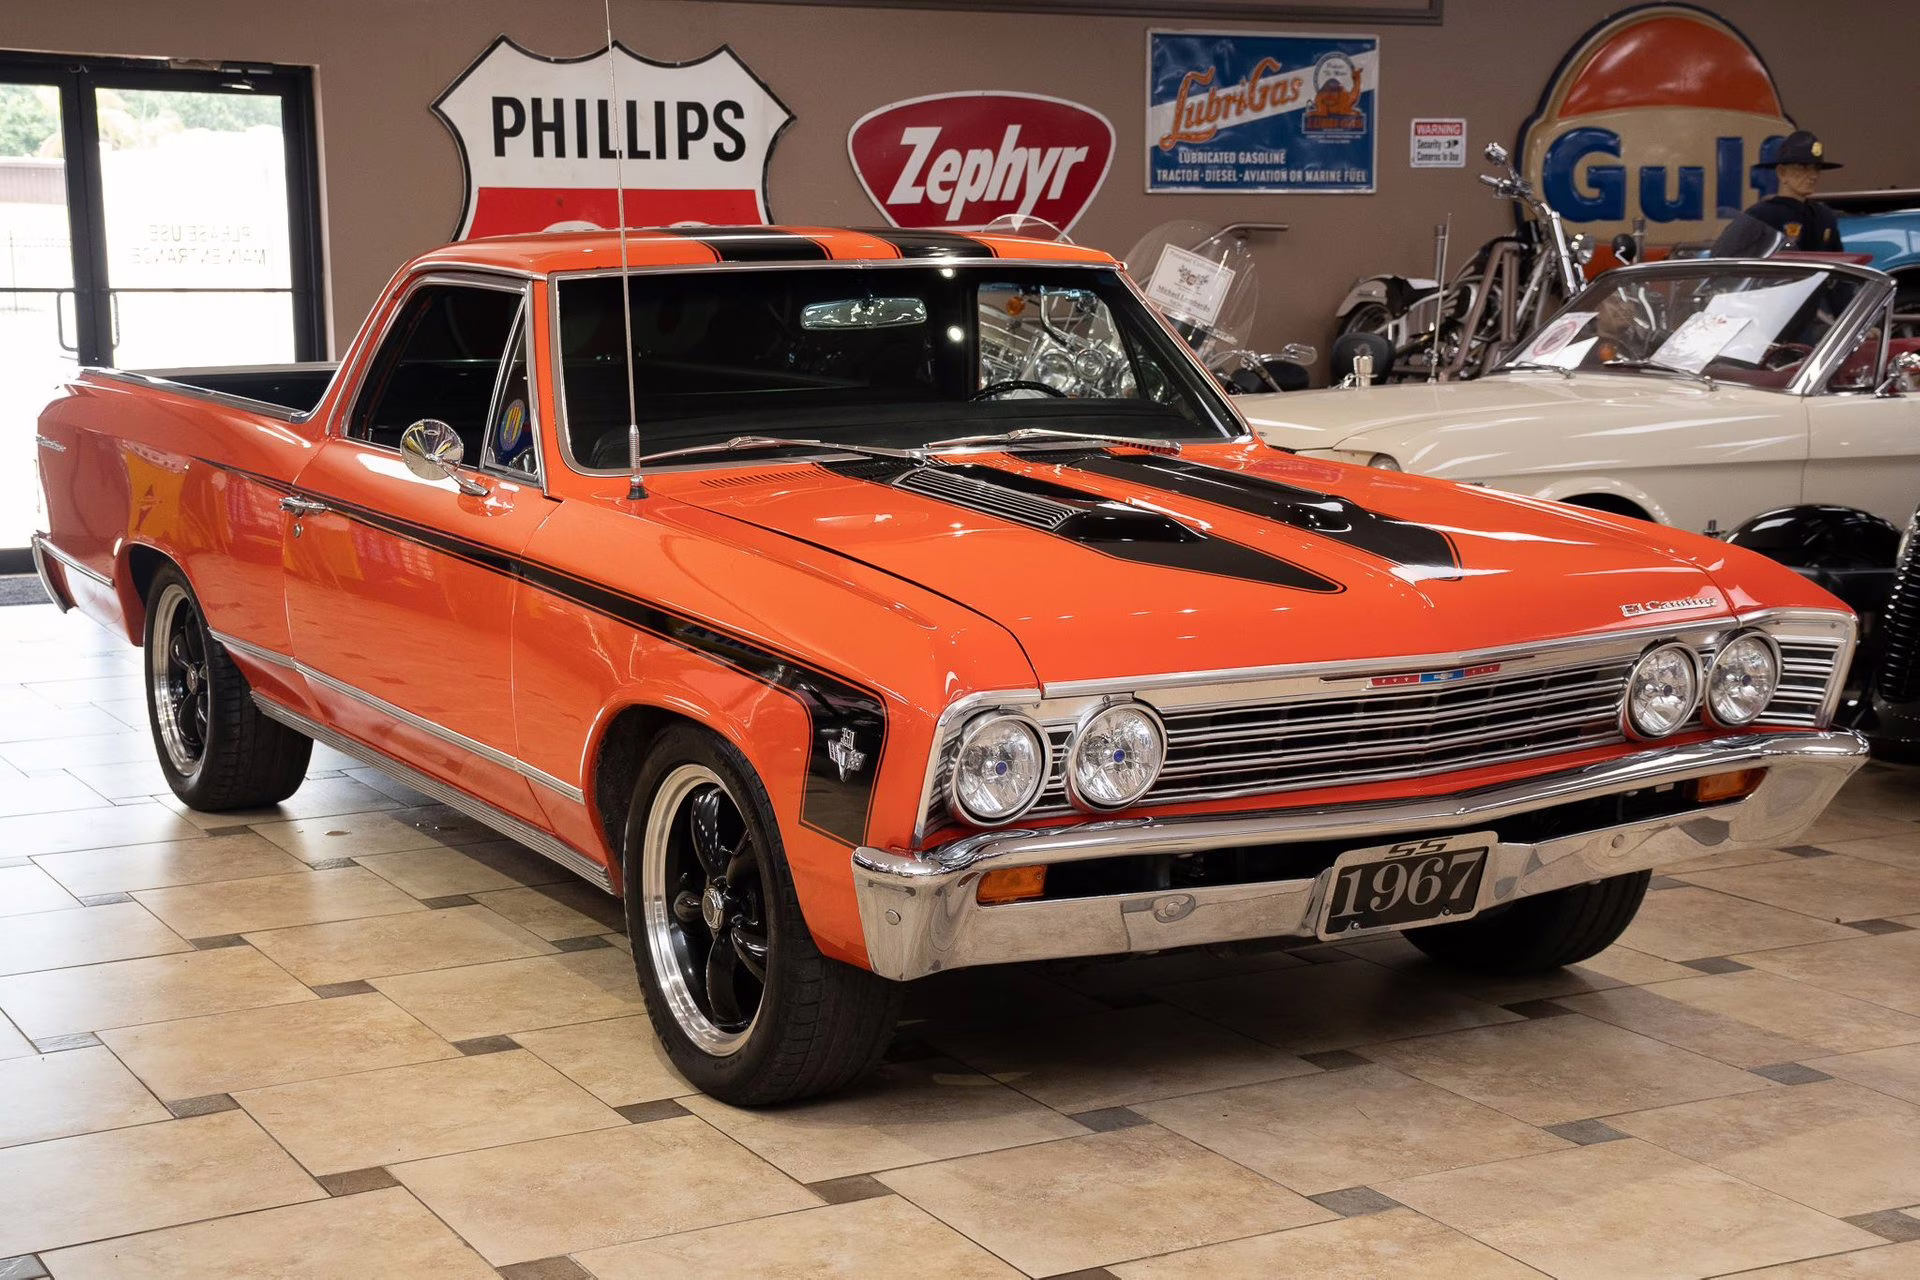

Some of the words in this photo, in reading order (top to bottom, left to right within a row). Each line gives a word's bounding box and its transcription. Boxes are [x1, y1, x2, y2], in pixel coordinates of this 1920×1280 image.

[491, 96, 747, 162] PHILLIPS
[1416, 124, 1461, 135] WARNING
[886, 124, 1090, 232] Zephyr
[1157, 169, 1200, 182] TRACTOR
[1204, 169, 1238, 182] DIESEL
[1243, 169, 1287, 182] AVIATION
[1289, 170, 1302, 182] OR
[1305, 170, 1341, 182] MARINE
[1344, 169, 1366, 182] FUEL
[1178, 151, 1236, 164] LUBRICATED
[1238, 151, 1286, 164] GASOLINE
[1542, 126, 1788, 224] Gulf
[1384, 836, 1454, 860] SS
[1330, 850, 1486, 918] 1967
